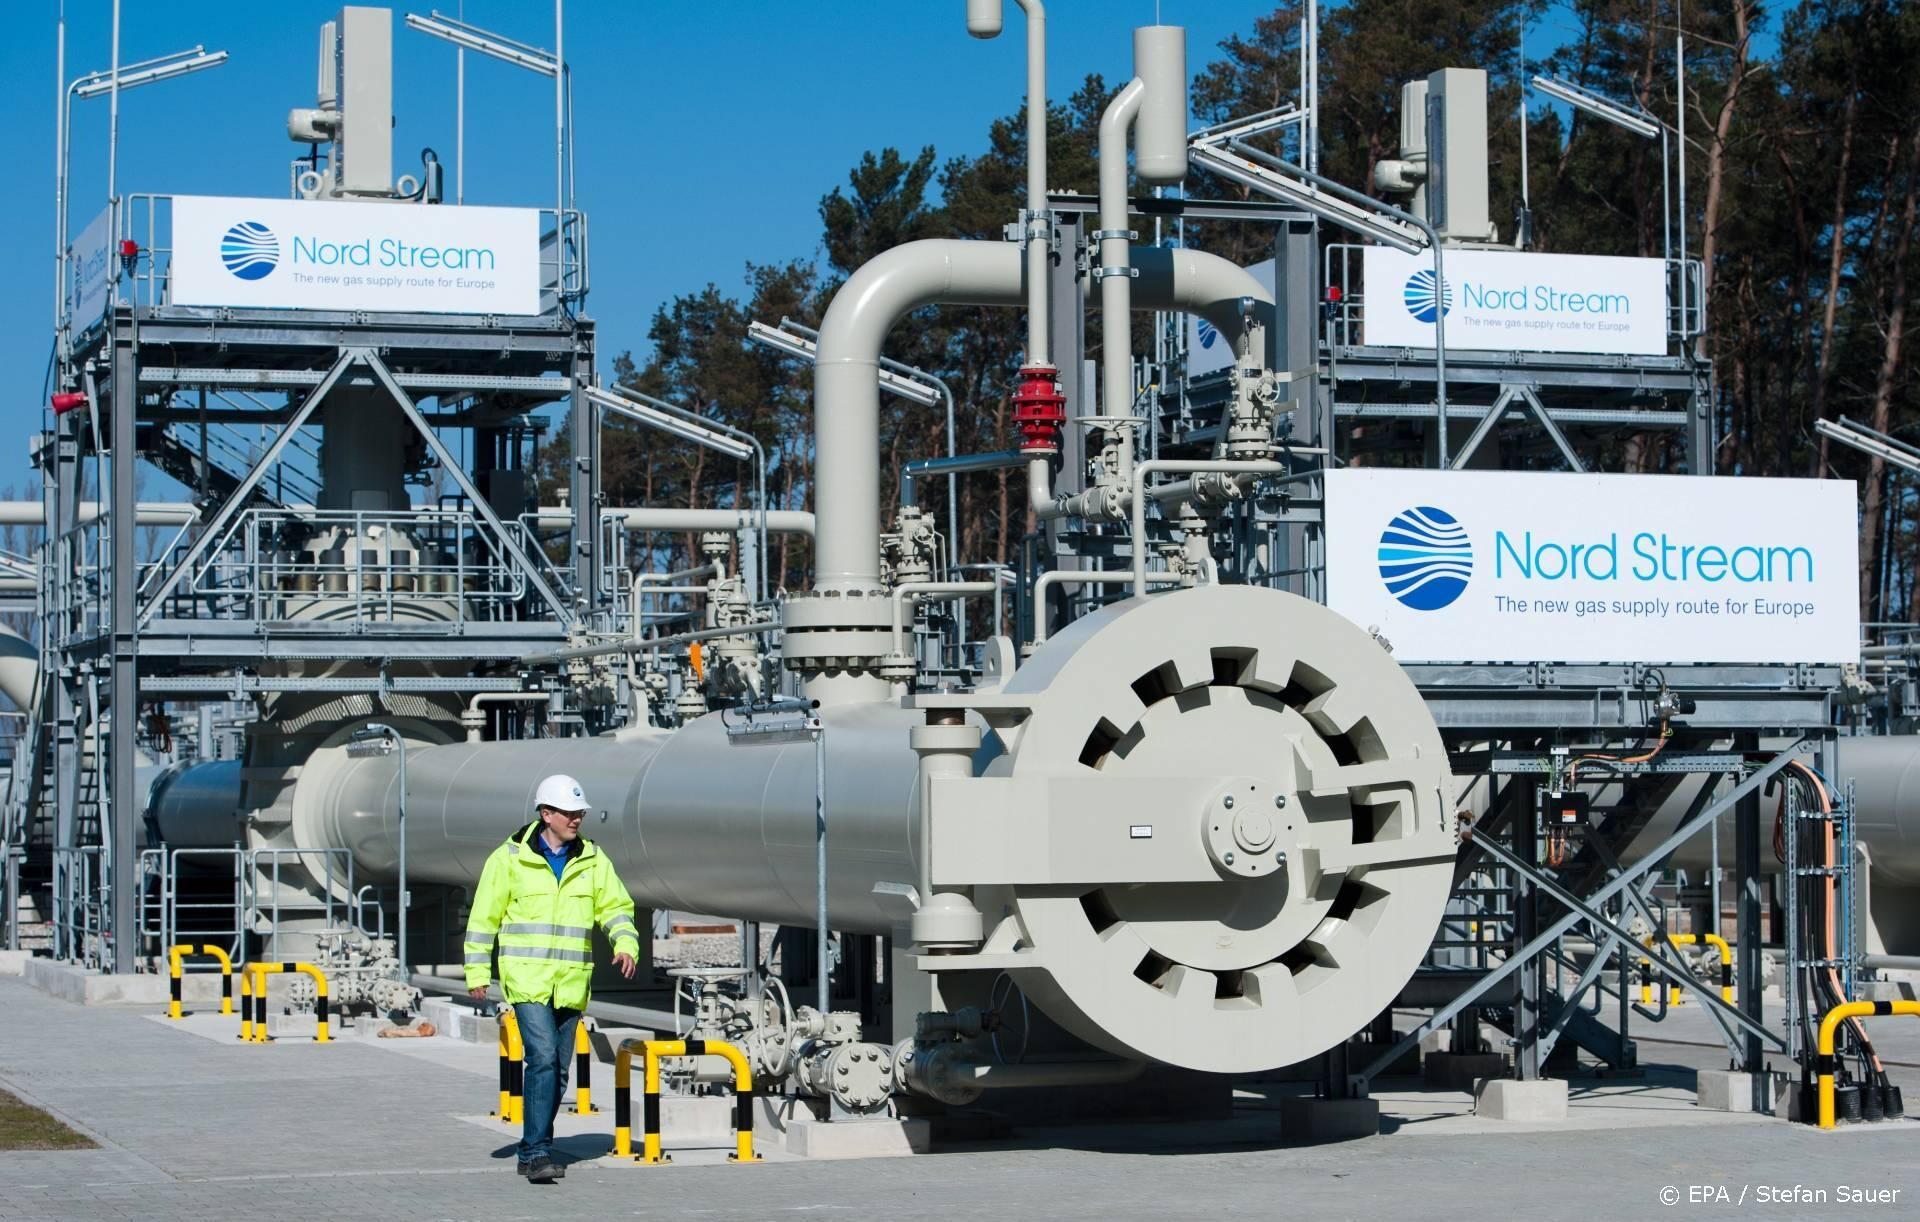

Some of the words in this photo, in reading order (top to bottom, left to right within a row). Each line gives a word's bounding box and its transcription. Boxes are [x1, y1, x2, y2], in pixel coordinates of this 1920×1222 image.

[293, 235, 371, 266] Nord
[379, 238, 495, 270] Stream
[293, 272, 313, 283] The
[317, 275, 340, 284] new
[343, 276, 364, 287] gas
[366, 274, 403, 287] supply
[406, 276, 435, 287] route
[438, 277, 453, 288] for
[456, 278, 495, 289] Europe
[1464, 282, 1528, 311] Nord
[1534, 285, 1630, 315] Stream
[1463, 316, 1481, 326] The
[1483, 319, 1501, 327] new
[1505, 319, 1521, 329] gas
[1524, 318, 1553, 330] supply
[1556, 319, 1581, 329] route
[1583, 319, 1595, 330] for
[1598, 320, 1630, 332] Europe
[1495, 530, 1618, 581] Nord
[1632, 532, 1814, 583] Stream
[1495, 595, 1528, 613] The
[1534, 599, 1569, 613] new
[1575, 600, 1606, 617] gas
[1612, 597, 1670, 617] supply
[1676, 600, 1720, 614] route
[1726, 597, 1748, 614] for
[1755, 598, 1815, 618] Europe
